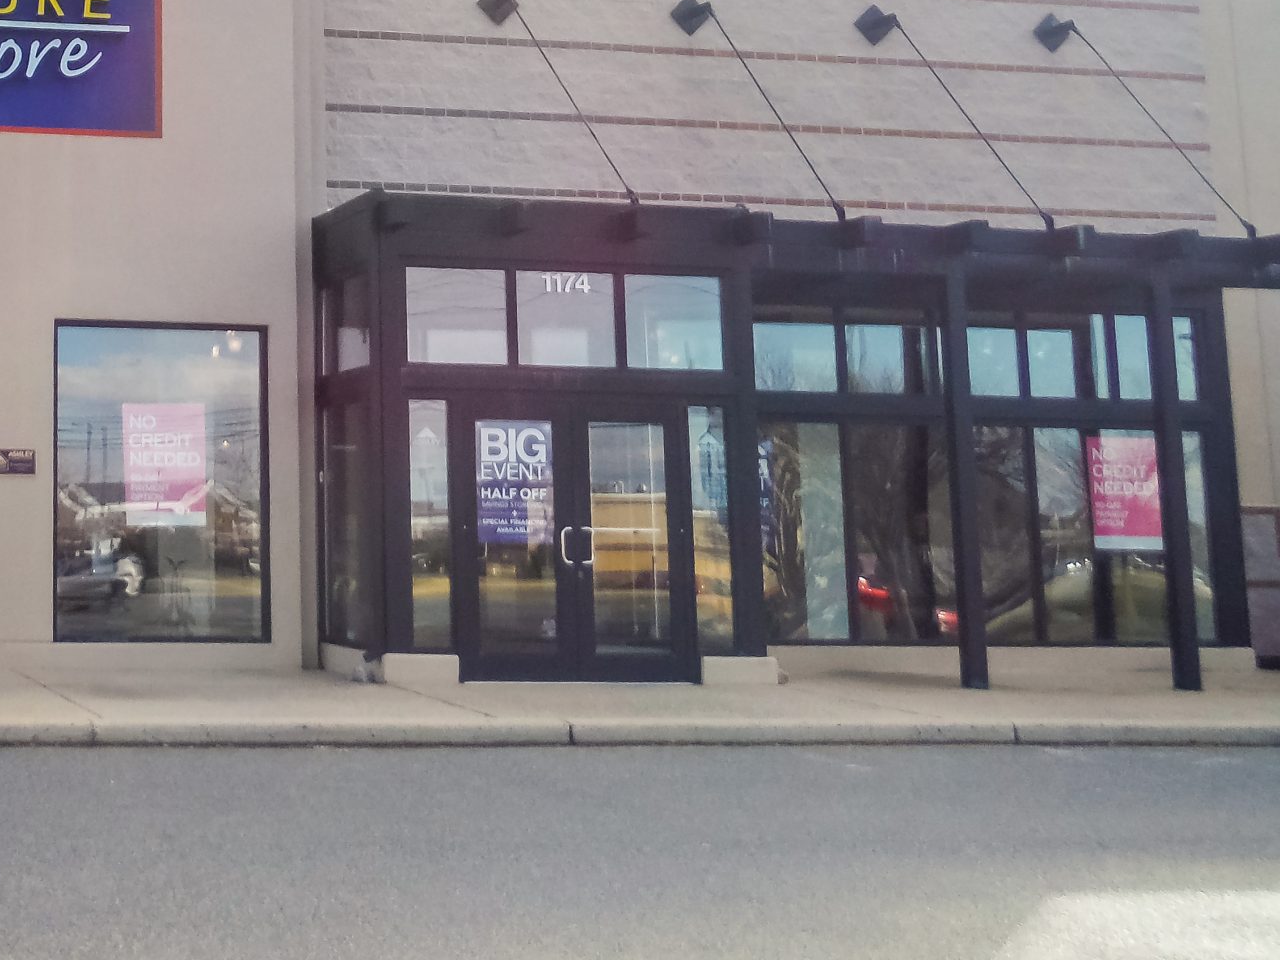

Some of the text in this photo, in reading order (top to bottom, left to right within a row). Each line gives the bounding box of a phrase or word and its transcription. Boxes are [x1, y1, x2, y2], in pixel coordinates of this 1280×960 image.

[541, 272, 591, 293] 1174
[129, 416, 157, 429] NO
[128, 432, 192, 447] CREDIT
[480, 427, 547, 463] BIG
[129, 451, 201, 467] NEEDED
[480, 462, 546, 480] EVENT
[1092, 464, 1147, 479] CREDIT
[481, 486, 547, 501] HALF OFF
